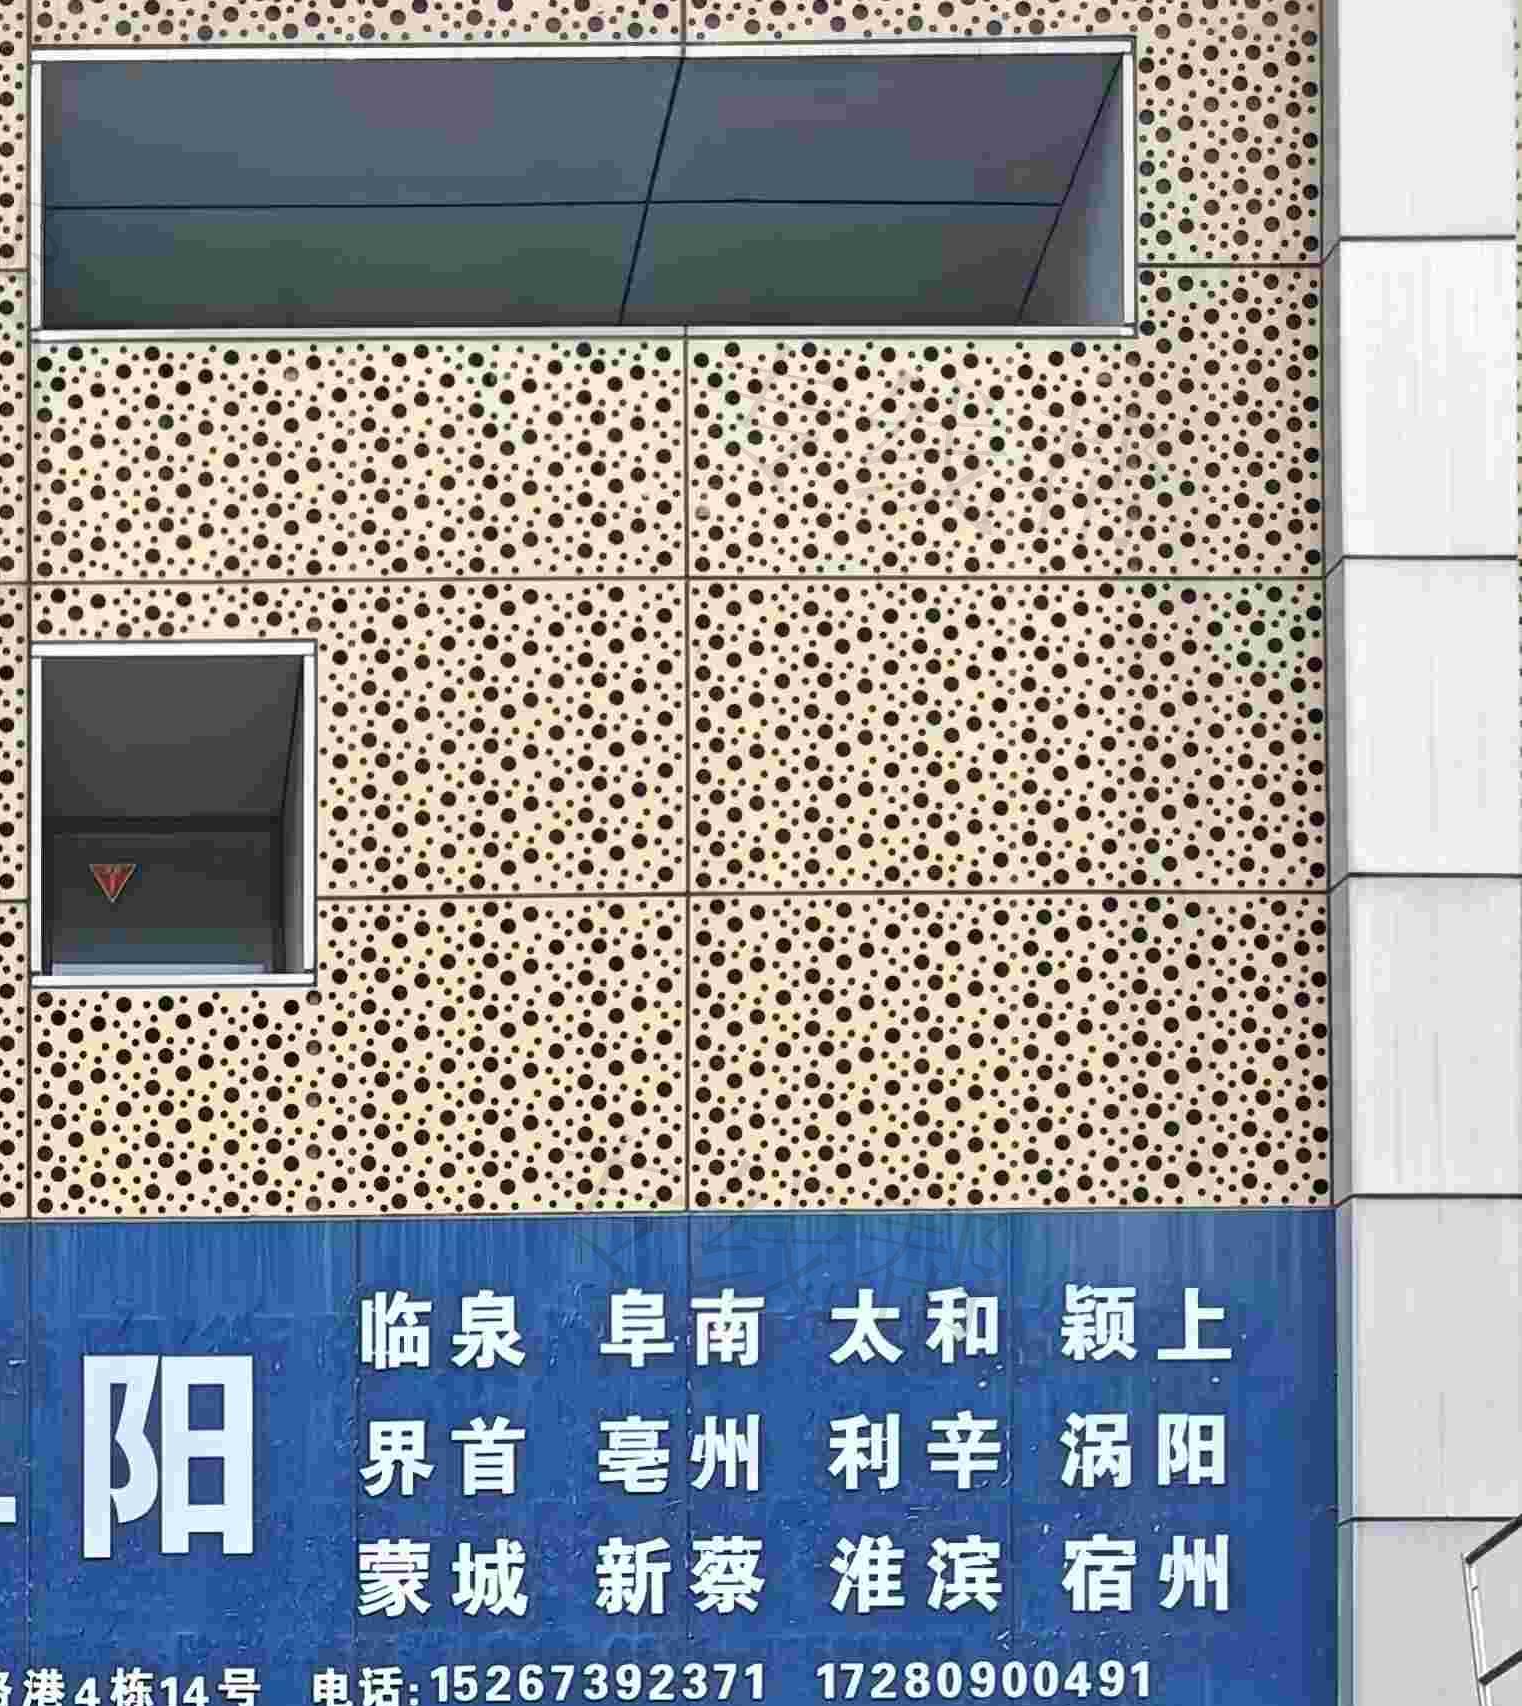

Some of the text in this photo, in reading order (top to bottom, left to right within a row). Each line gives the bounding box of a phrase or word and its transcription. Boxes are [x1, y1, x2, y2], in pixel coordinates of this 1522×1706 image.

[359, 1288, 526, 1371] 临泉
[598, 1287, 768, 1369] 阜南
[827, 1285, 1001, 1366] 太和
[359, 1415, 528, 1498] 界首
[827, 1411, 1003, 1491] 利辛
[1060, 1411, 1229, 1490] 涡阳
[356, 1531, 1230, 1619] 蒙城 新蔡 淮滨 宿州
[815, 1659, 1153, 1701] 17280900491
